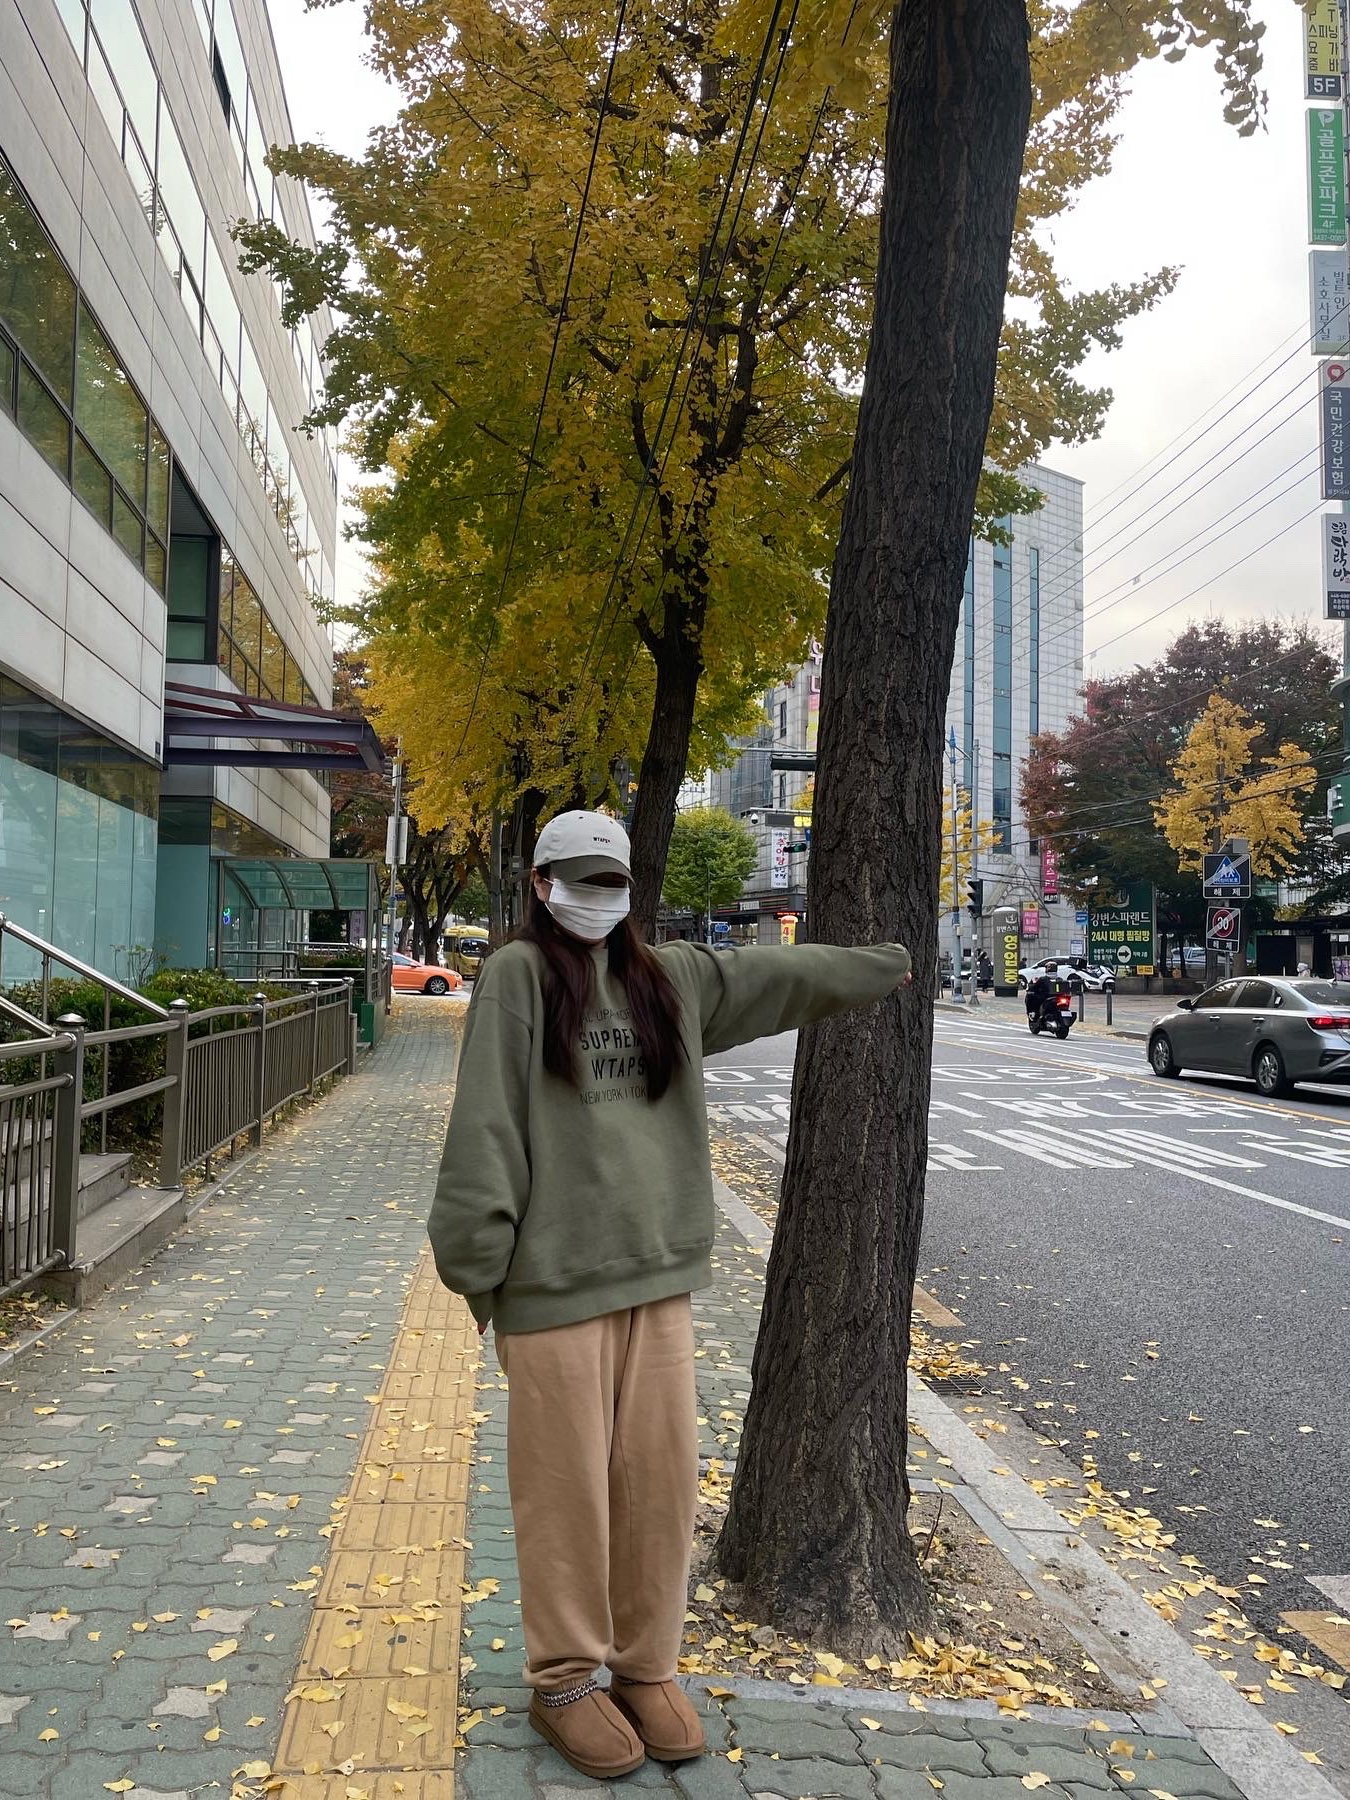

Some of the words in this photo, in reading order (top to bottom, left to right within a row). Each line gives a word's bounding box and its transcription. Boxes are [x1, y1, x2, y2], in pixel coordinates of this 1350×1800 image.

[1309, 25, 1337, 38] 스피닝
[1309, 41, 1338, 55] 요가
[1309, 57, 1338, 72] 줌바
[1314, 78, 1335, 93] 5F
[1317, 129, 1338, 219] 골프존파크
[1322, 220, 1335, 229] 4F
[1318, 276, 1331, 341] 소호사무실
[1330, 391, 1344, 486] 국민건강보험
[1331, 535, 1350, 582] 다락방
[1090, 911, 1151, 927] 강변스파랜드
[1091, 930, 1108, 942] 24시
[1126, 930, 1150, 942] 찜질방
[1004, 935, 1018, 984] 영업중
[591, 1056, 647, 1080] WTAPS
[579, 1089, 601, 1105] NEW
[602, 1087, 623, 1102] YORK
